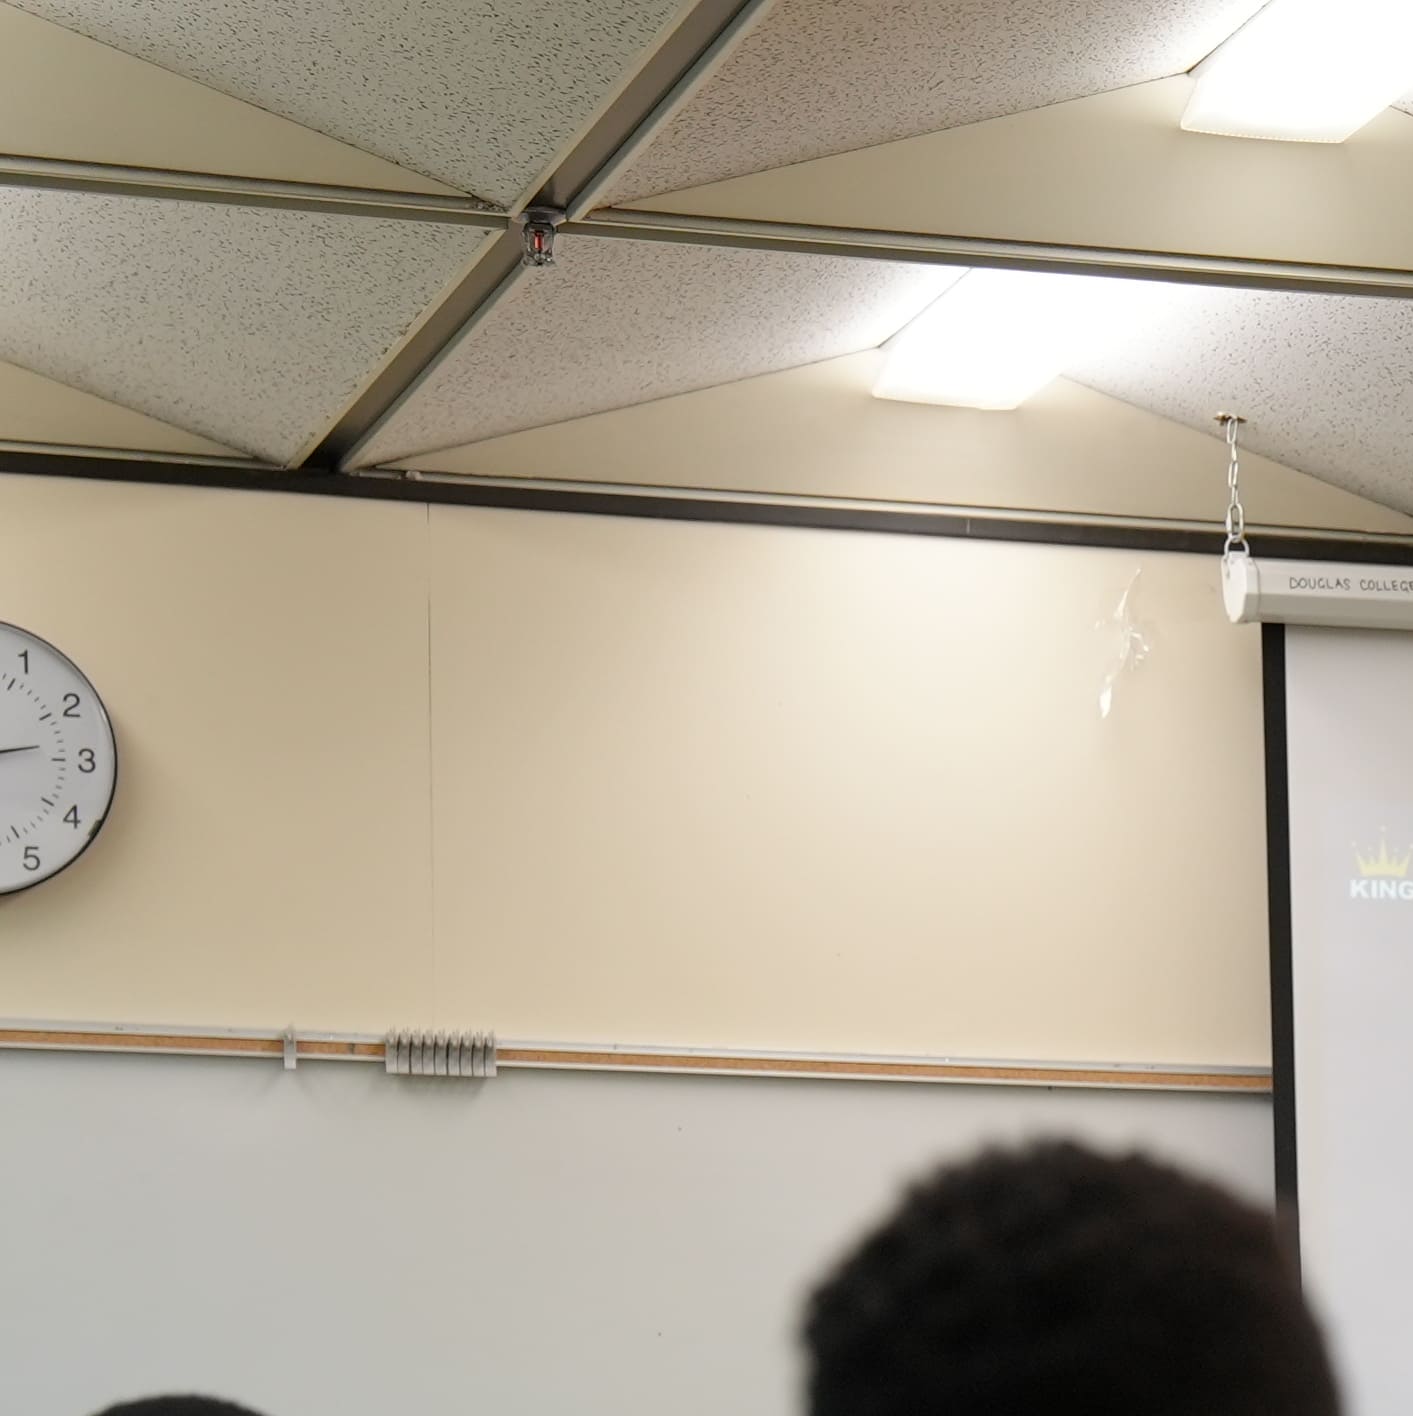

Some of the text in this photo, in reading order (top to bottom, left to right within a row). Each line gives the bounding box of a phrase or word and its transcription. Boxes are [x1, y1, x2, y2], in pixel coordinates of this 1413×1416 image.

[1289, 576, 1350, 590] DOUGLAS
[18, 649, 28, 675] 1
[62, 693, 81, 718] 2
[78, 748, 96, 773] 3
[62, 804, 81, 829] 4
[23, 846, 41, 871] 5
